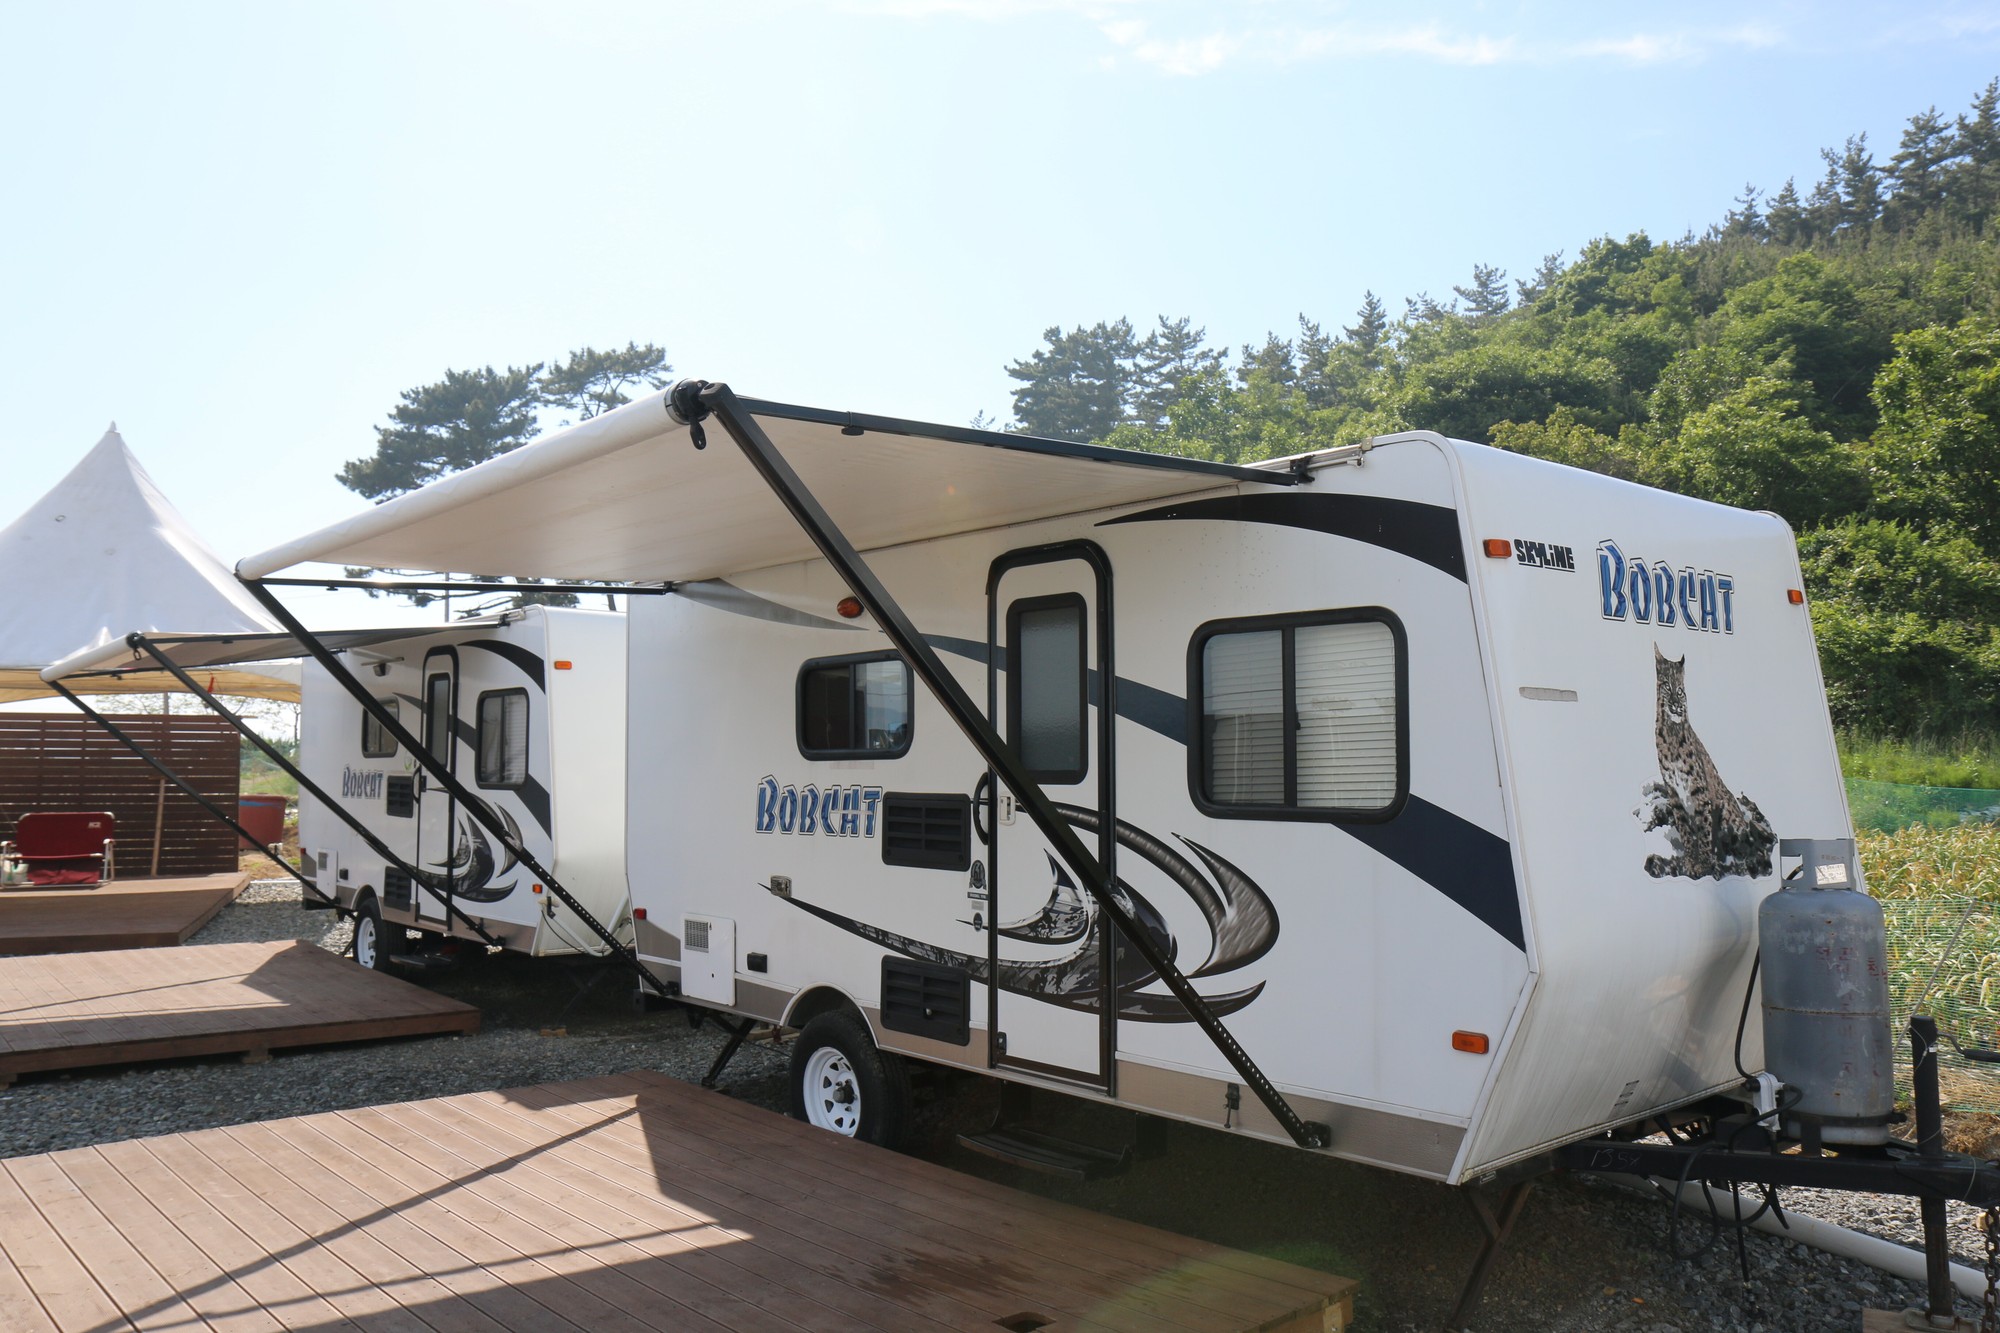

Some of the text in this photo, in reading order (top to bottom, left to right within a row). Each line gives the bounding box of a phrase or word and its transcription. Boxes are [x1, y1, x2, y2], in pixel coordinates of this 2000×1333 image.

[1596, 539, 1735, 635] BOBCAT
[342, 763, 384, 799] BOBCAT
[756, 774, 883, 838] BOBCAT
